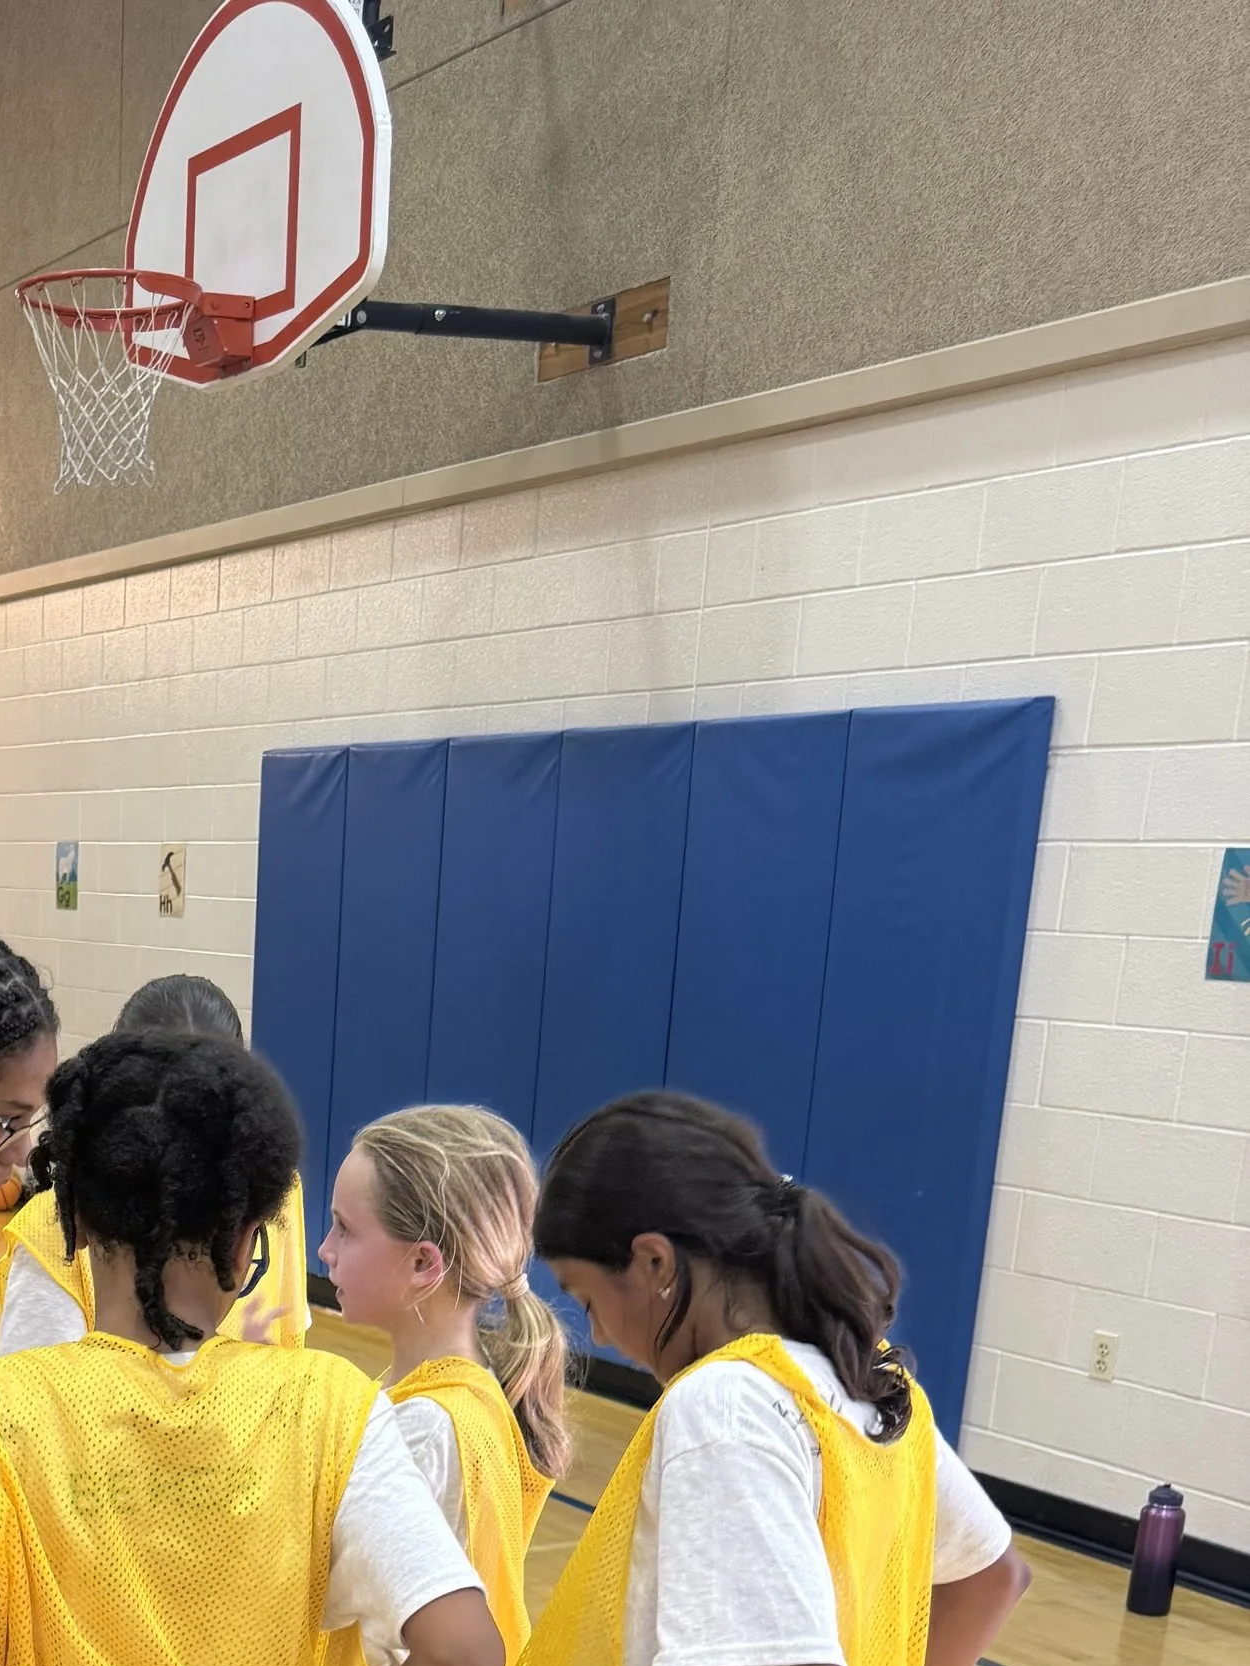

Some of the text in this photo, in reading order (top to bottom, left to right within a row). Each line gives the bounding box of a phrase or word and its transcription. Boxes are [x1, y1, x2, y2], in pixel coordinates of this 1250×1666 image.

[57, 886, 70, 908] Gg
[159, 894, 173, 914] Hh
[1209, 942, 1236, 975] Ii
